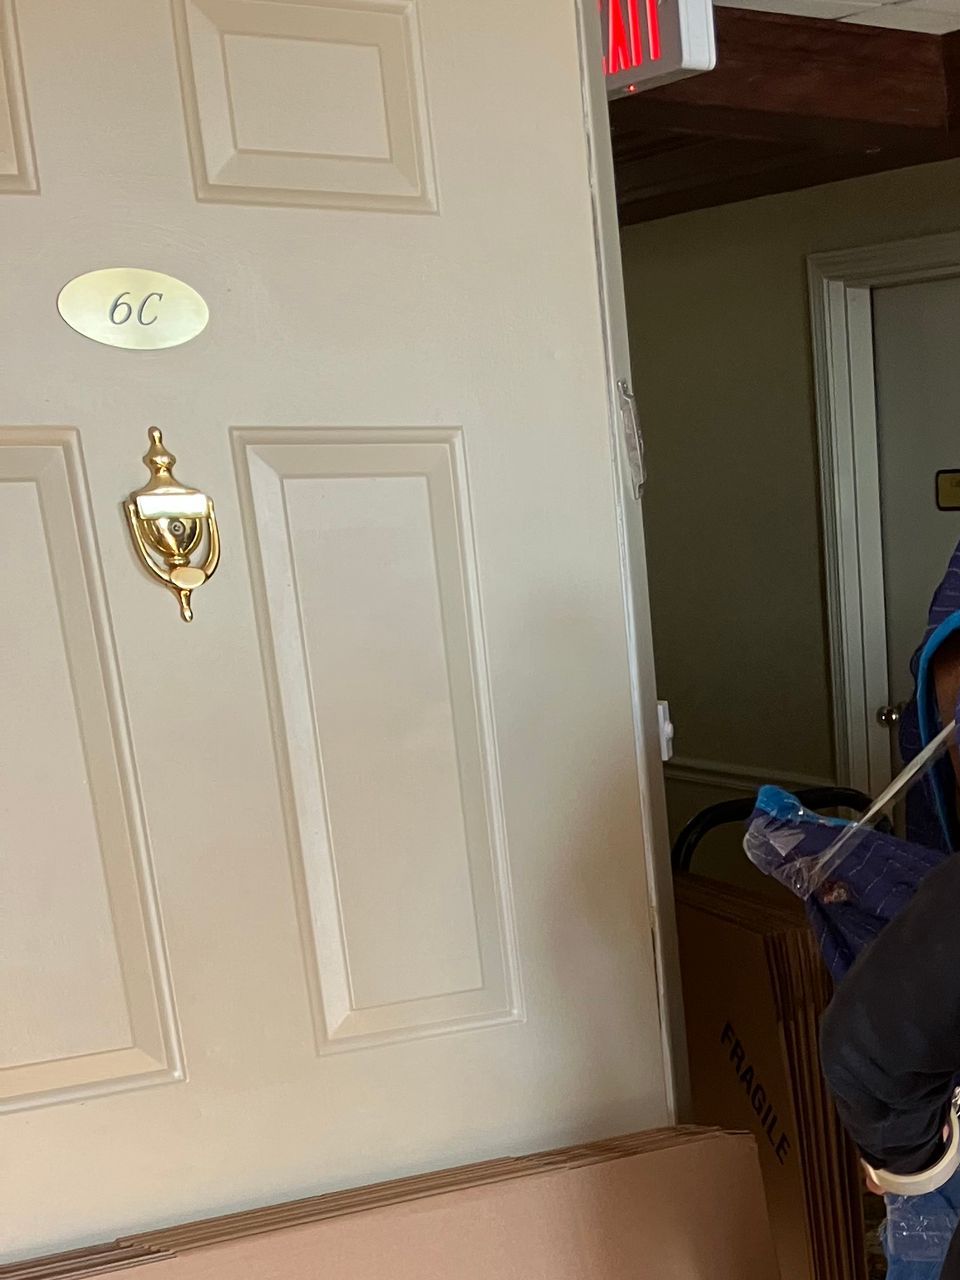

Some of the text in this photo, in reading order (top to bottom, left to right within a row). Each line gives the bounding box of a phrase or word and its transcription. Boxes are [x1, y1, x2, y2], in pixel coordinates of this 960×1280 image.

[597, 0, 661, 76] XIT
[109, 291, 163, 326] 6C
[720, 1022, 790, 1165] FRAGILE
